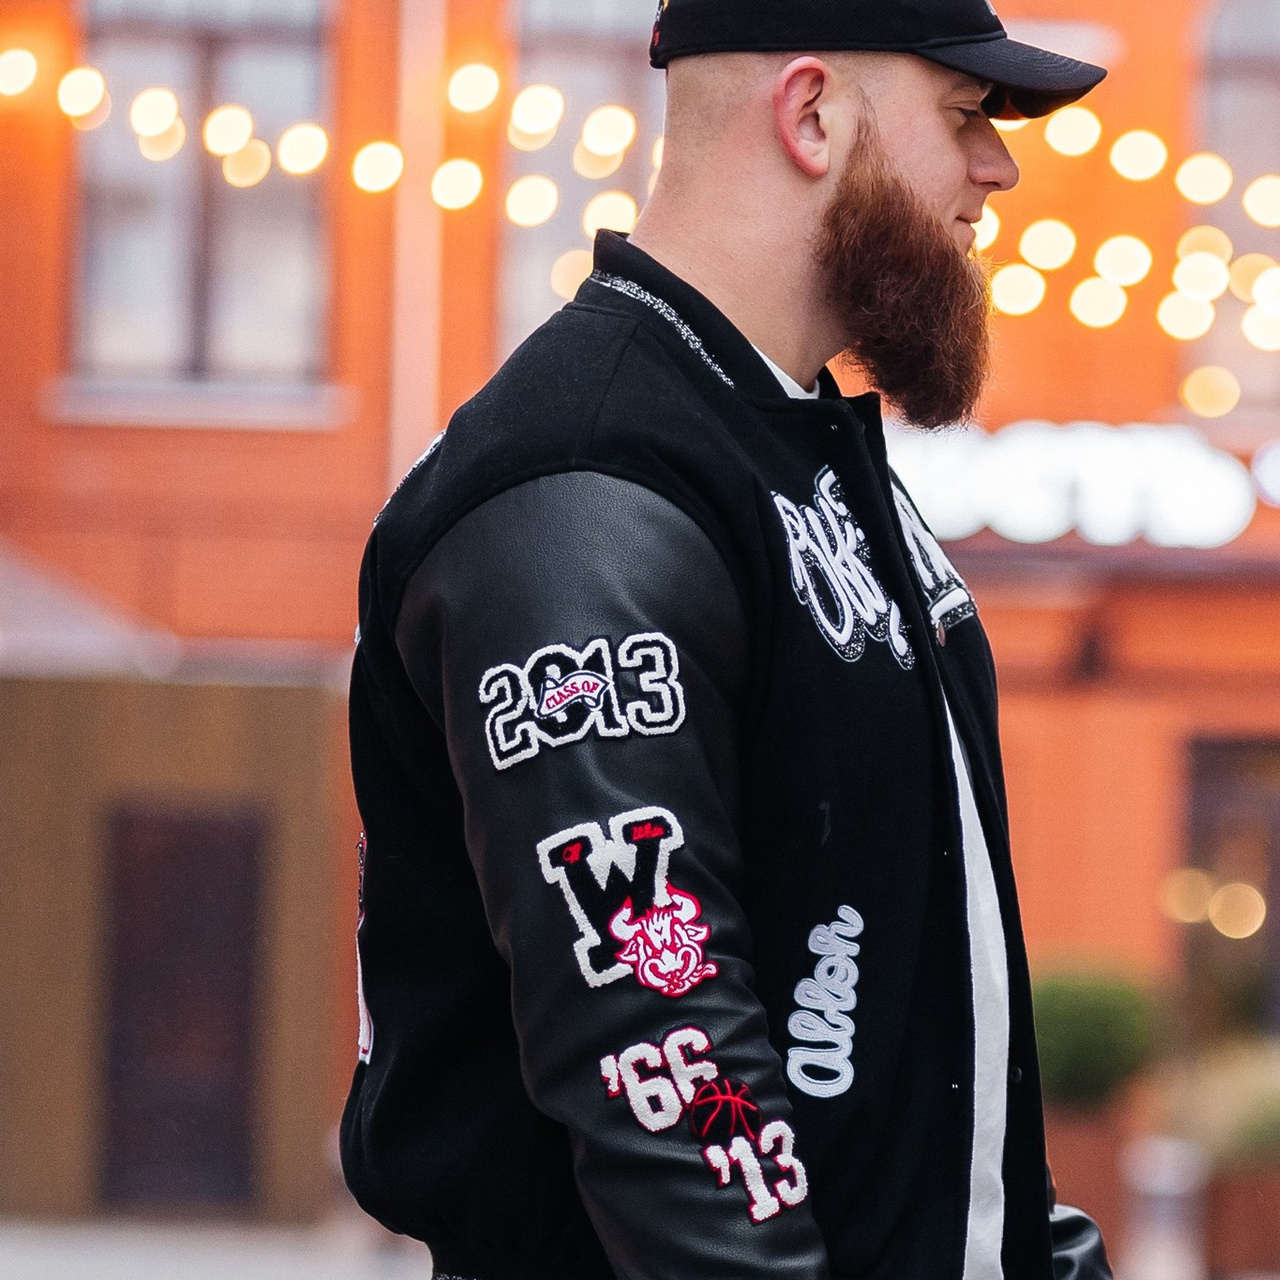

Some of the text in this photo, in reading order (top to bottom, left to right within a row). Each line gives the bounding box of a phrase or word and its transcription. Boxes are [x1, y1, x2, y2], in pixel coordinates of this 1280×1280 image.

[479, 632, 686, 770] 2013
[545, 680, 600, 710] CLASS OF
[536, 806, 684, 989] W
[704, 1119, 809, 1223] '13
